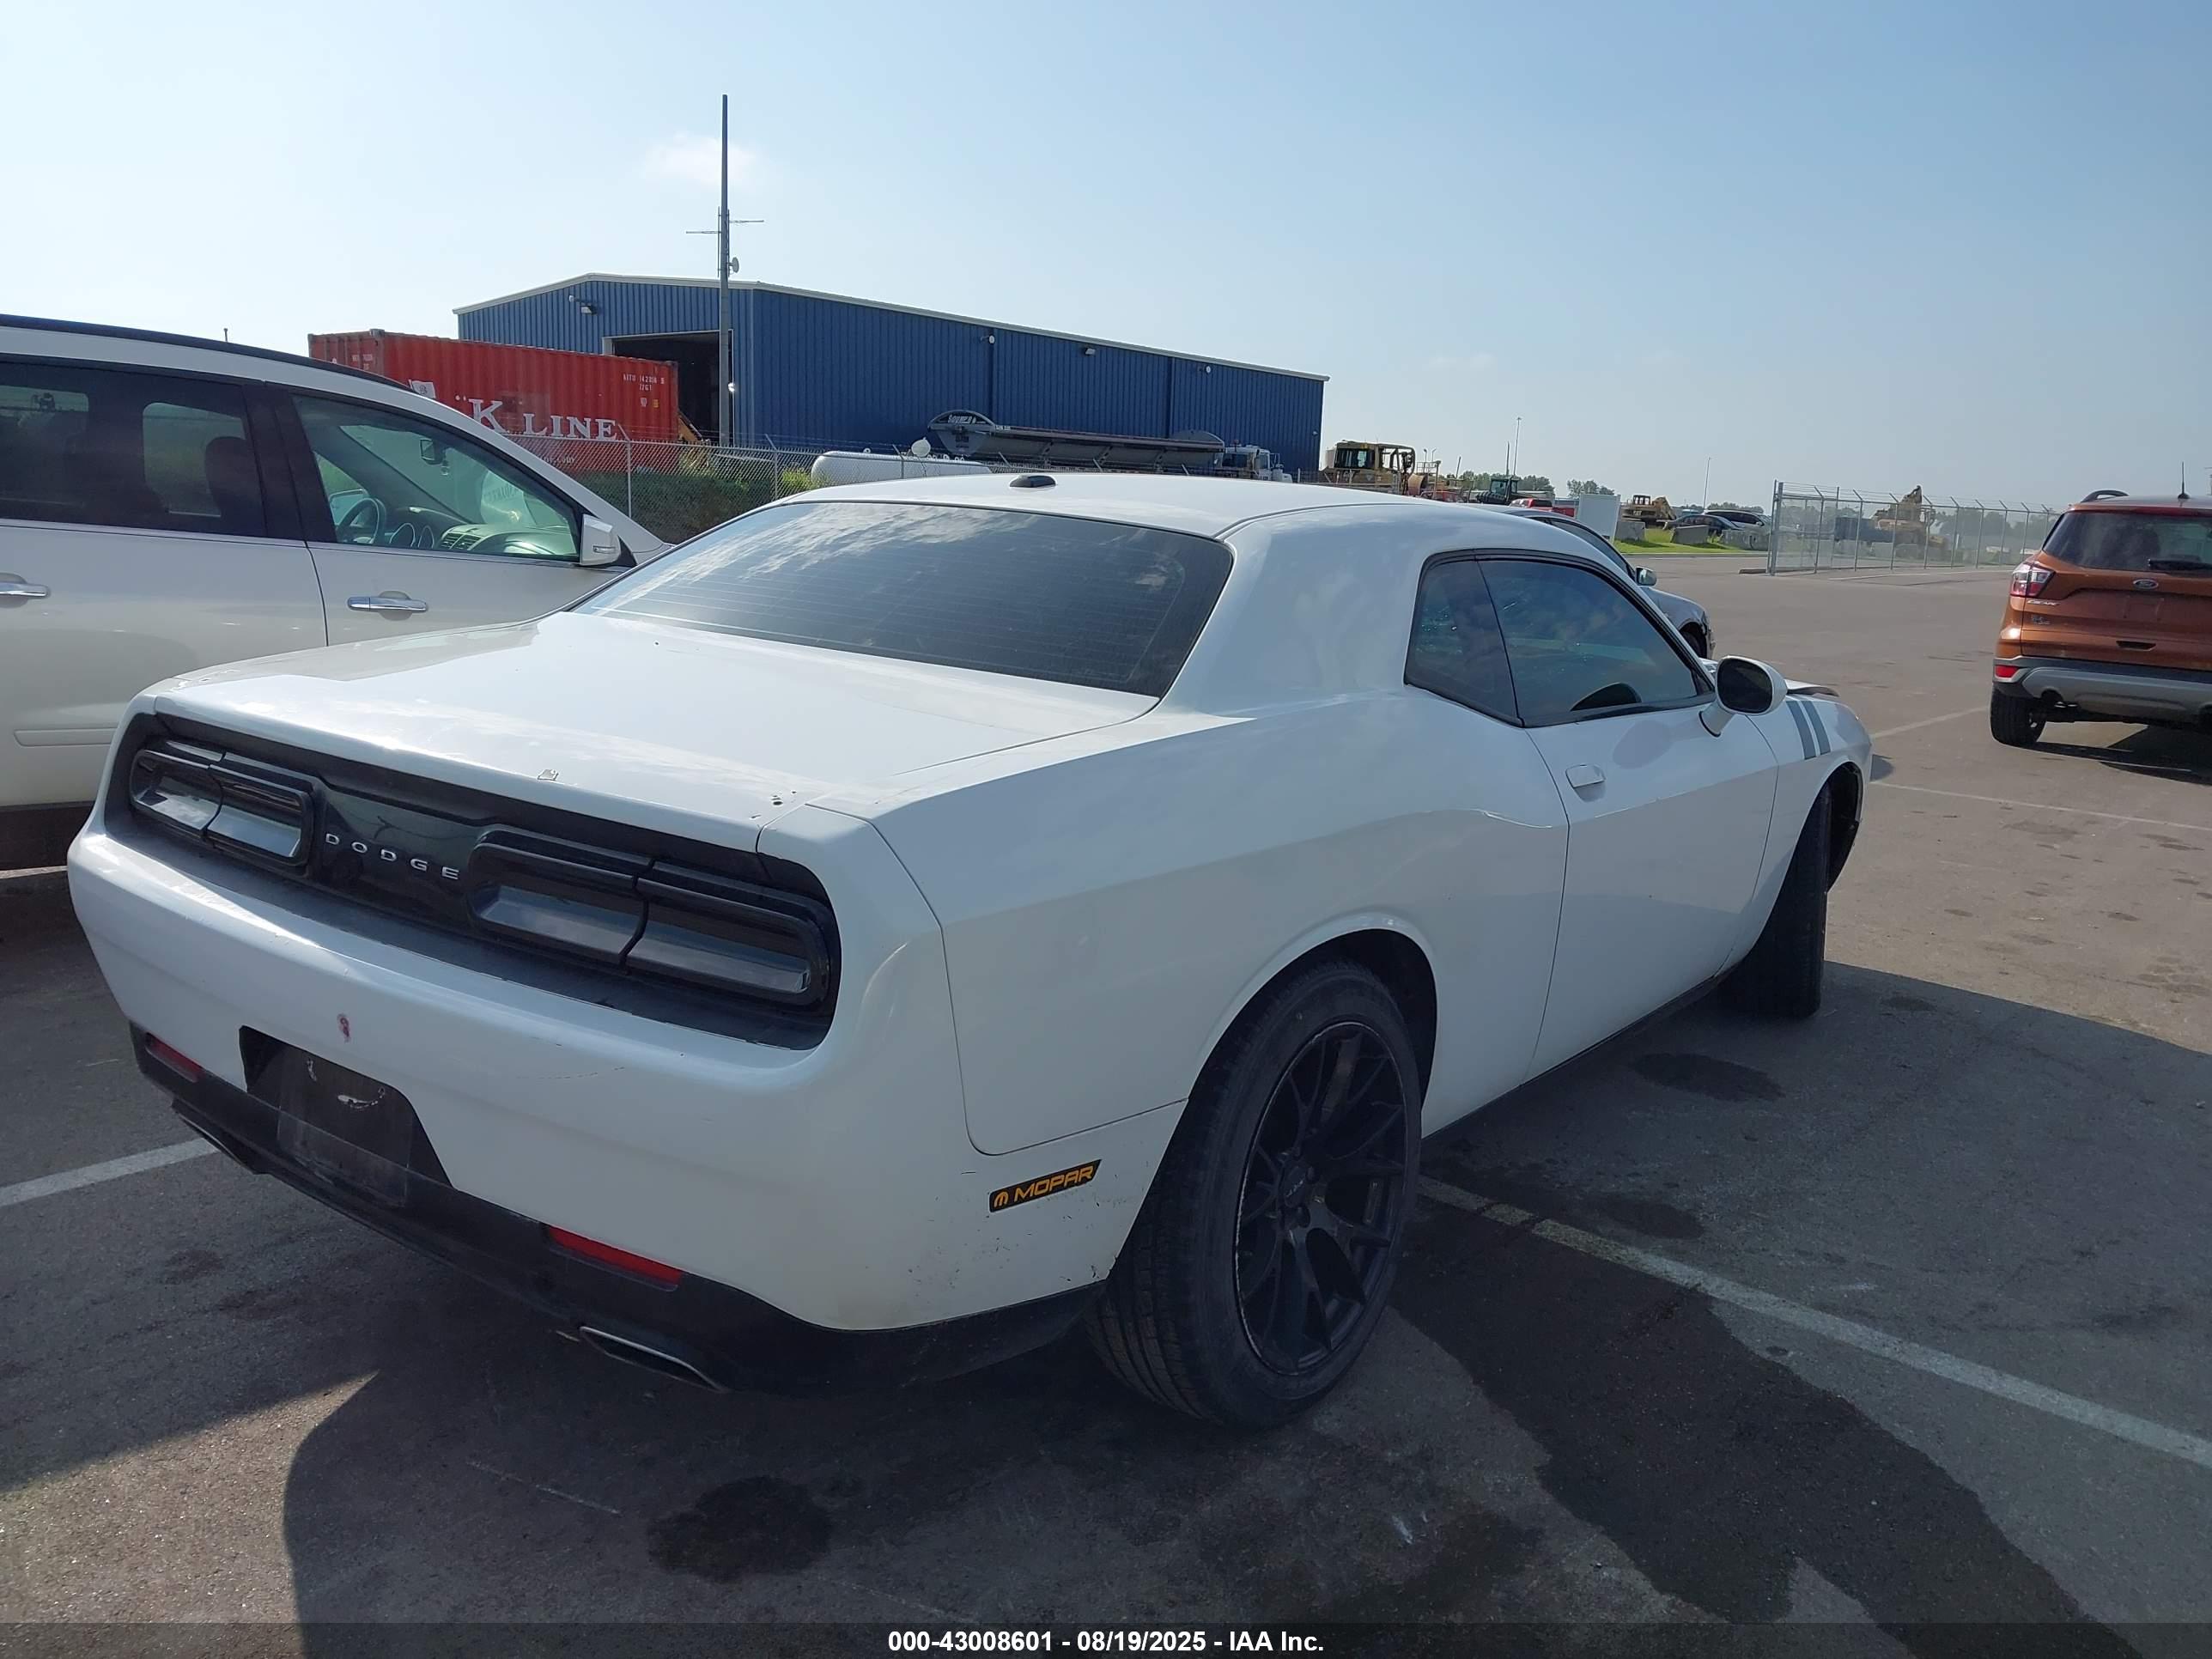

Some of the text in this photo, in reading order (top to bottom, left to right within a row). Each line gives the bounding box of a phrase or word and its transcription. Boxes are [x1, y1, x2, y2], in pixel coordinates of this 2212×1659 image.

[523, 413, 617, 441] LINE
[325, 833, 459, 880] DODGE
[1014, 1164, 1094, 1202] MOPAR
